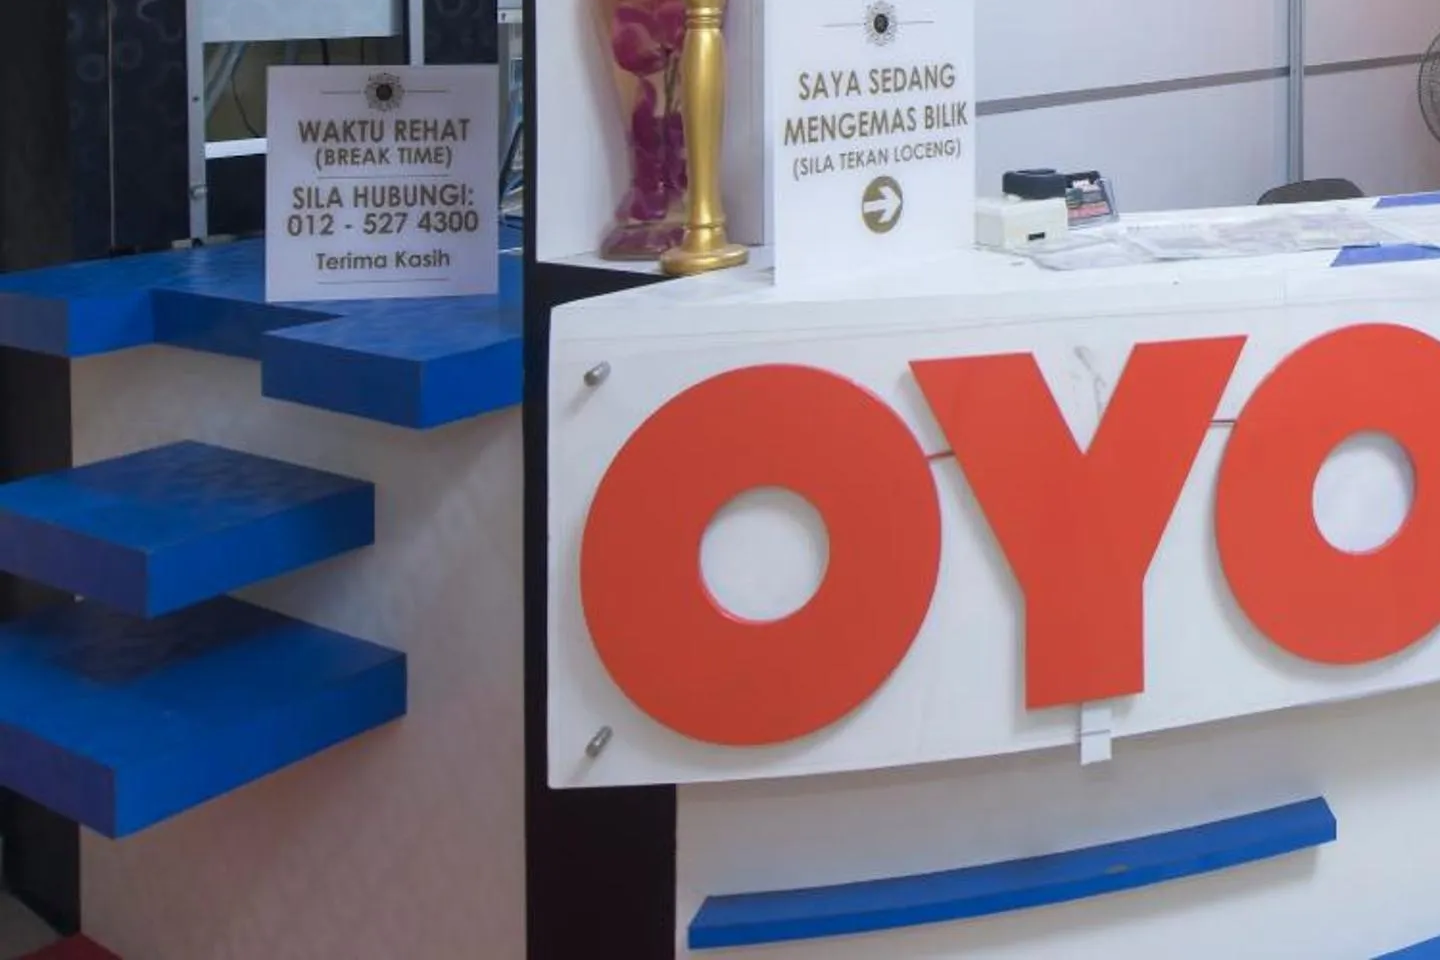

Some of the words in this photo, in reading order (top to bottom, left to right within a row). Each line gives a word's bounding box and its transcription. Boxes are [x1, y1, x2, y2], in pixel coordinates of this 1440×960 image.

[798, 71, 861, 101] SAYA
[869, 63, 956, 94] SEDANG
[298, 120, 384, 143] WAKTU
[395, 118, 471, 141] REHAT
[784, 107, 917, 146] MENGEMAS
[924, 101, 968, 131] BILIK
[315, 147, 390, 171] (BREAK
[398, 145, 453, 169] TIME)
[793, 151, 835, 181] (SILA
[840, 147, 889, 171] TEKAN
[894, 139, 961, 164] LOCENG)
[292, 187, 343, 210] SILA
[353, 183, 474, 209] HUBUNGI:
[287, 214, 334, 237] 012
[363, 212, 407, 235] 527
[417, 210, 479, 234] 4300
[317, 252, 387, 270] Terima
[396, 250, 450, 269] Kasih
